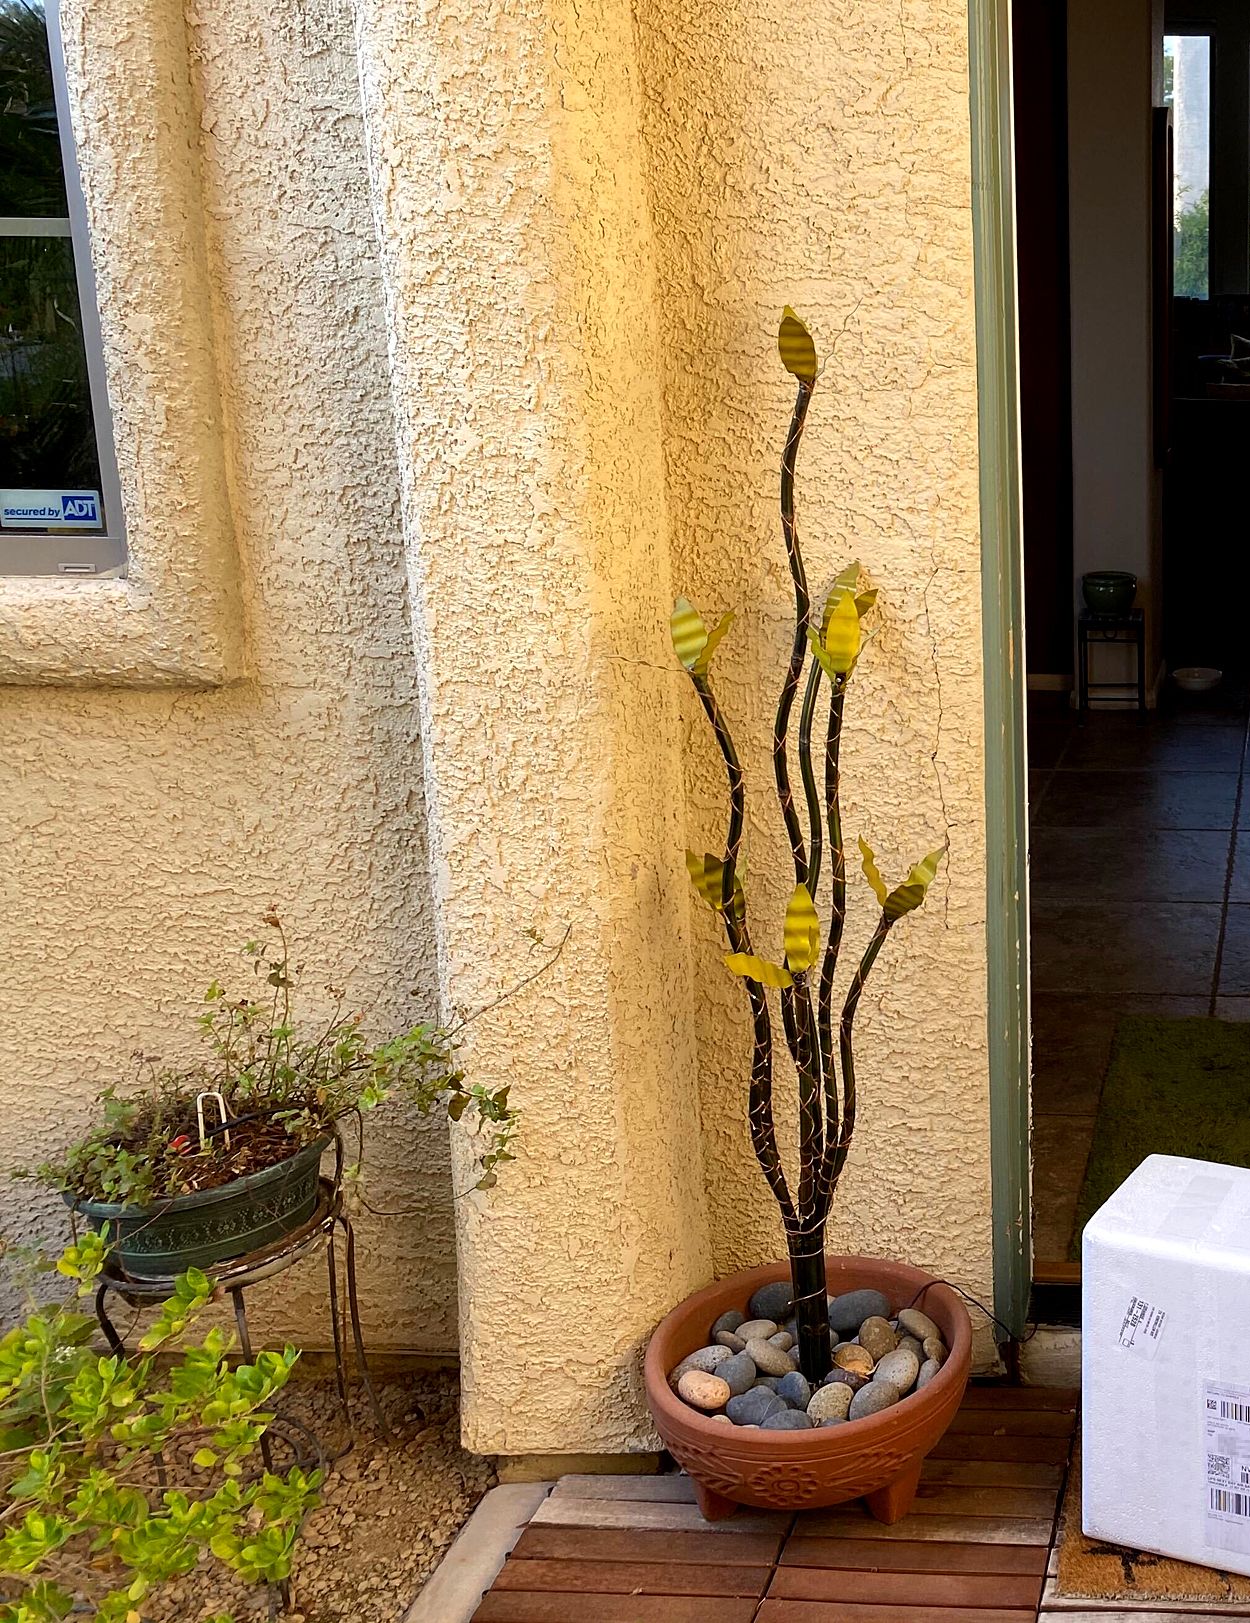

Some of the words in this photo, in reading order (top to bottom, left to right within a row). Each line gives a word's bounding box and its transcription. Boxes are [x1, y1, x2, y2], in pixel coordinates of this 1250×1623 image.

[4, 507, 46, 516] secured
[48, 507, 61, 518] by
[63, 500, 95, 517] ADT
